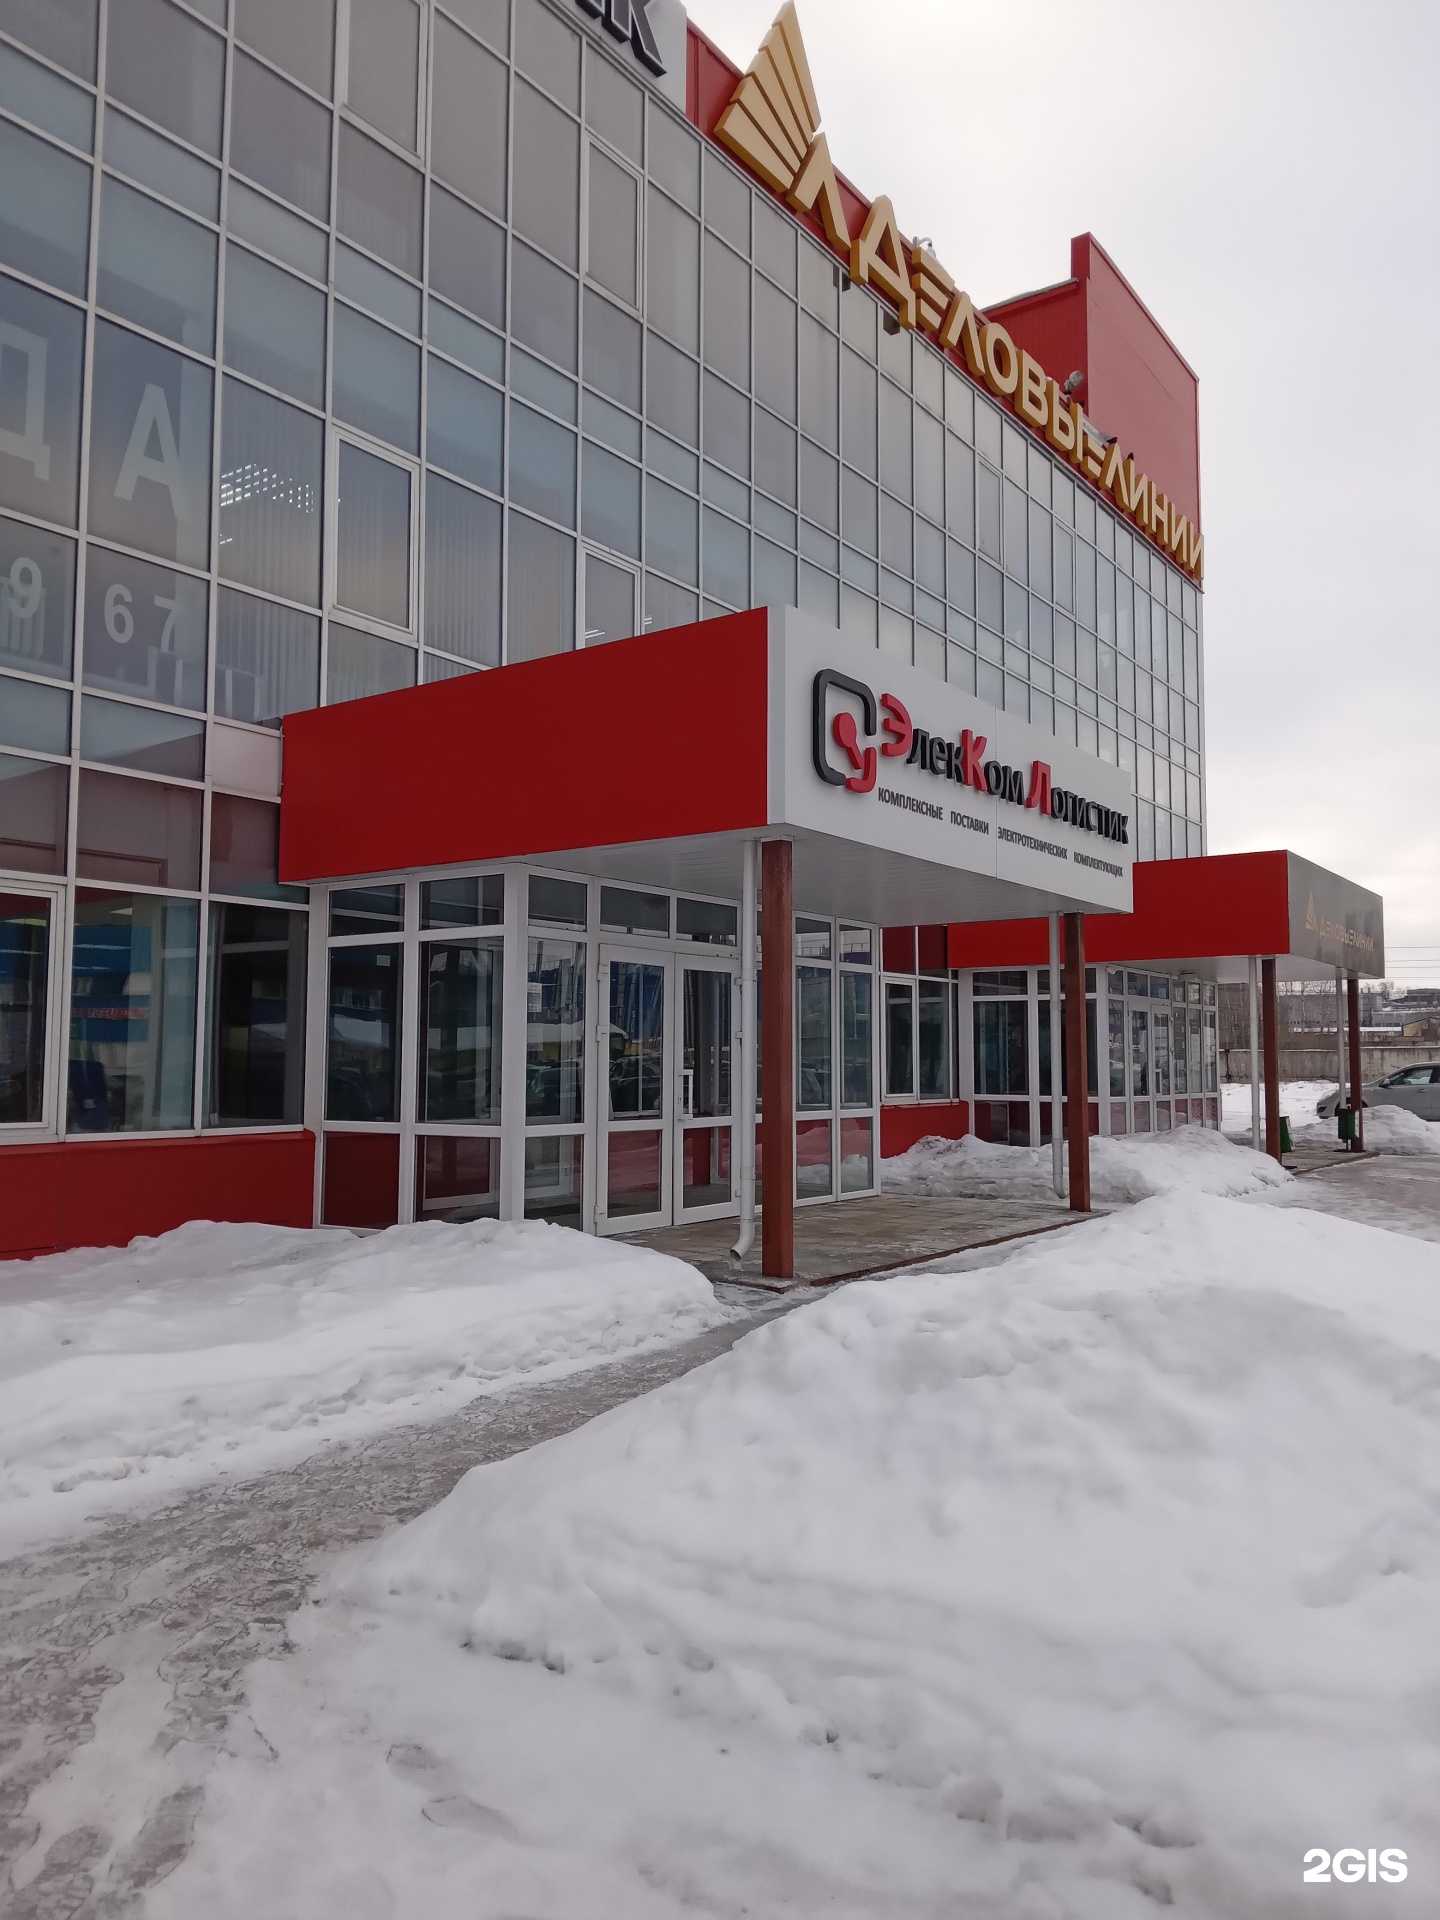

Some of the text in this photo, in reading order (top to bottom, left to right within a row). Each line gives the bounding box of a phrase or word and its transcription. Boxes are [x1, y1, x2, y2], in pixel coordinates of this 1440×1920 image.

[1098, 440, 1204, 582] ЛИНИИ
[878, 787, 944, 821] КОМПЛЕКСНЫЕ
[950, 810, 990, 836] ПОСТАВКИ
[997, 826, 1068, 860] ЭЛЕКТРОТЕХНИЧЕСКИХ
